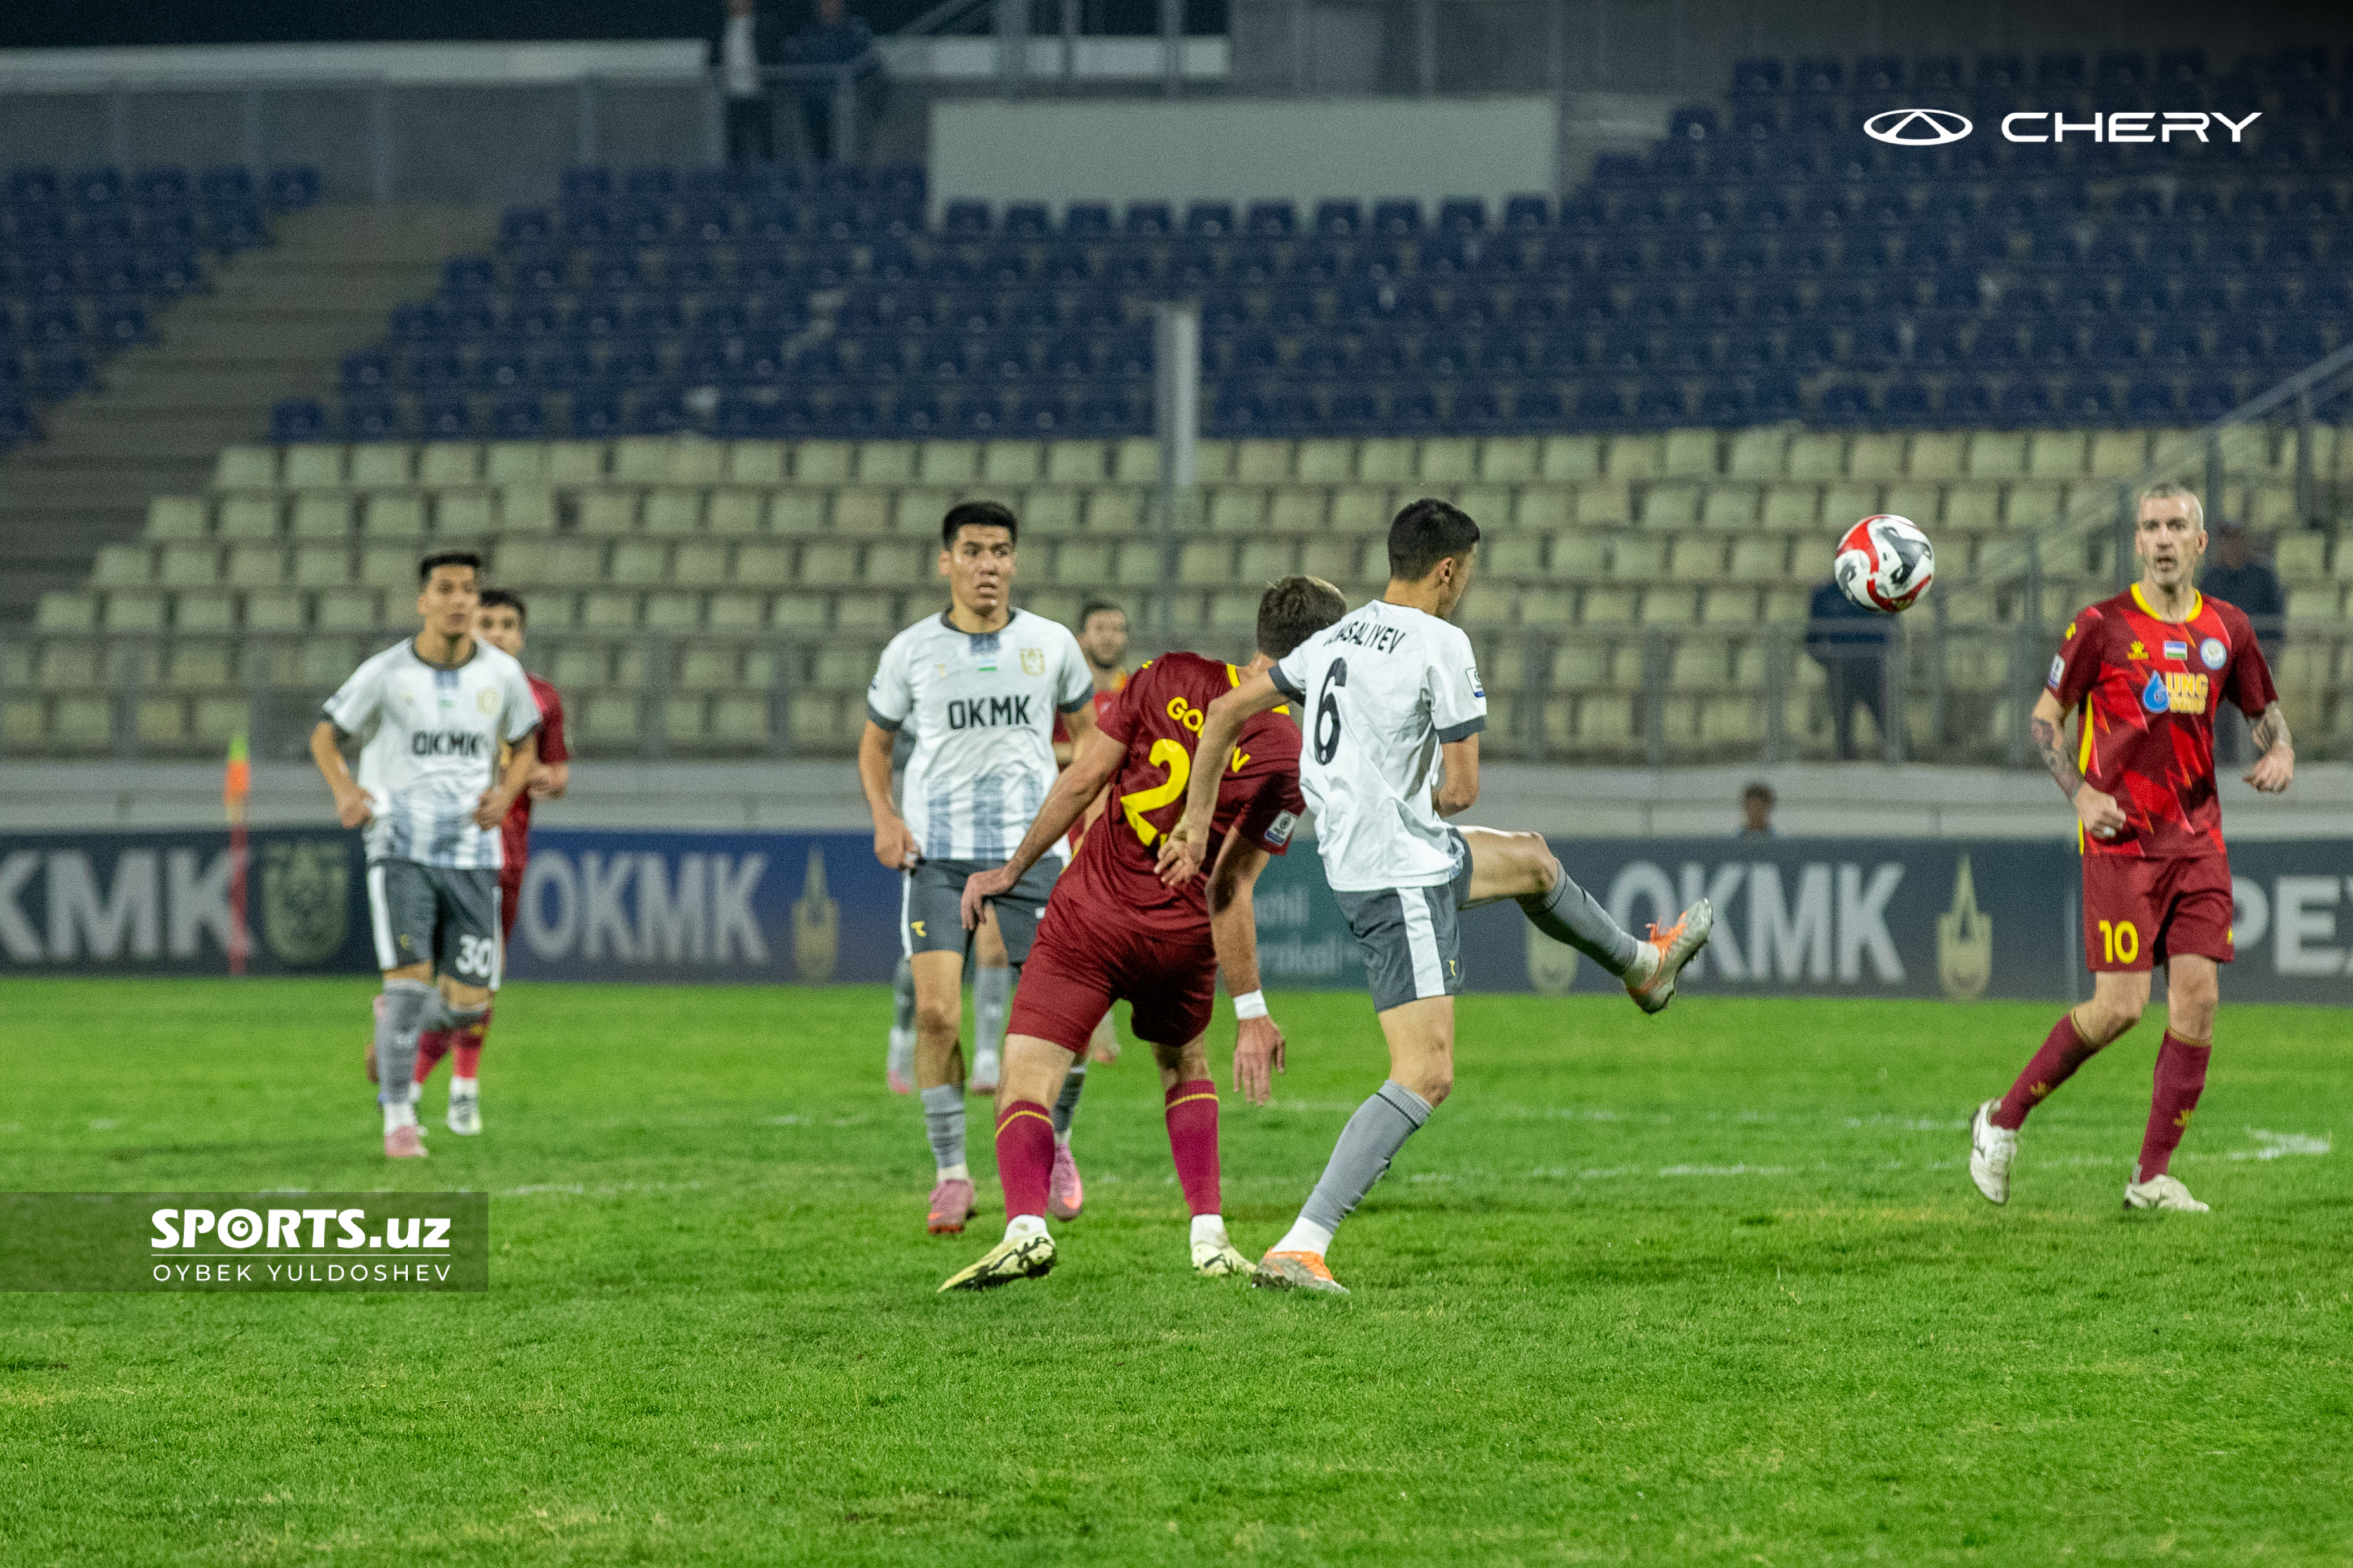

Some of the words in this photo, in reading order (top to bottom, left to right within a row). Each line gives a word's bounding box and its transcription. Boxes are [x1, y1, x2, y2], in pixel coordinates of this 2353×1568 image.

[948, 695, 1031, 730] OKMK
[1314, 657, 1348, 765] 6
[412, 730, 483, 757] OKMK
[521, 848, 770, 965] OKMK
[1607, 860, 1903, 983] OKMK
[455, 934, 493, 977] 30
[2099, 919, 2140, 964] 10
